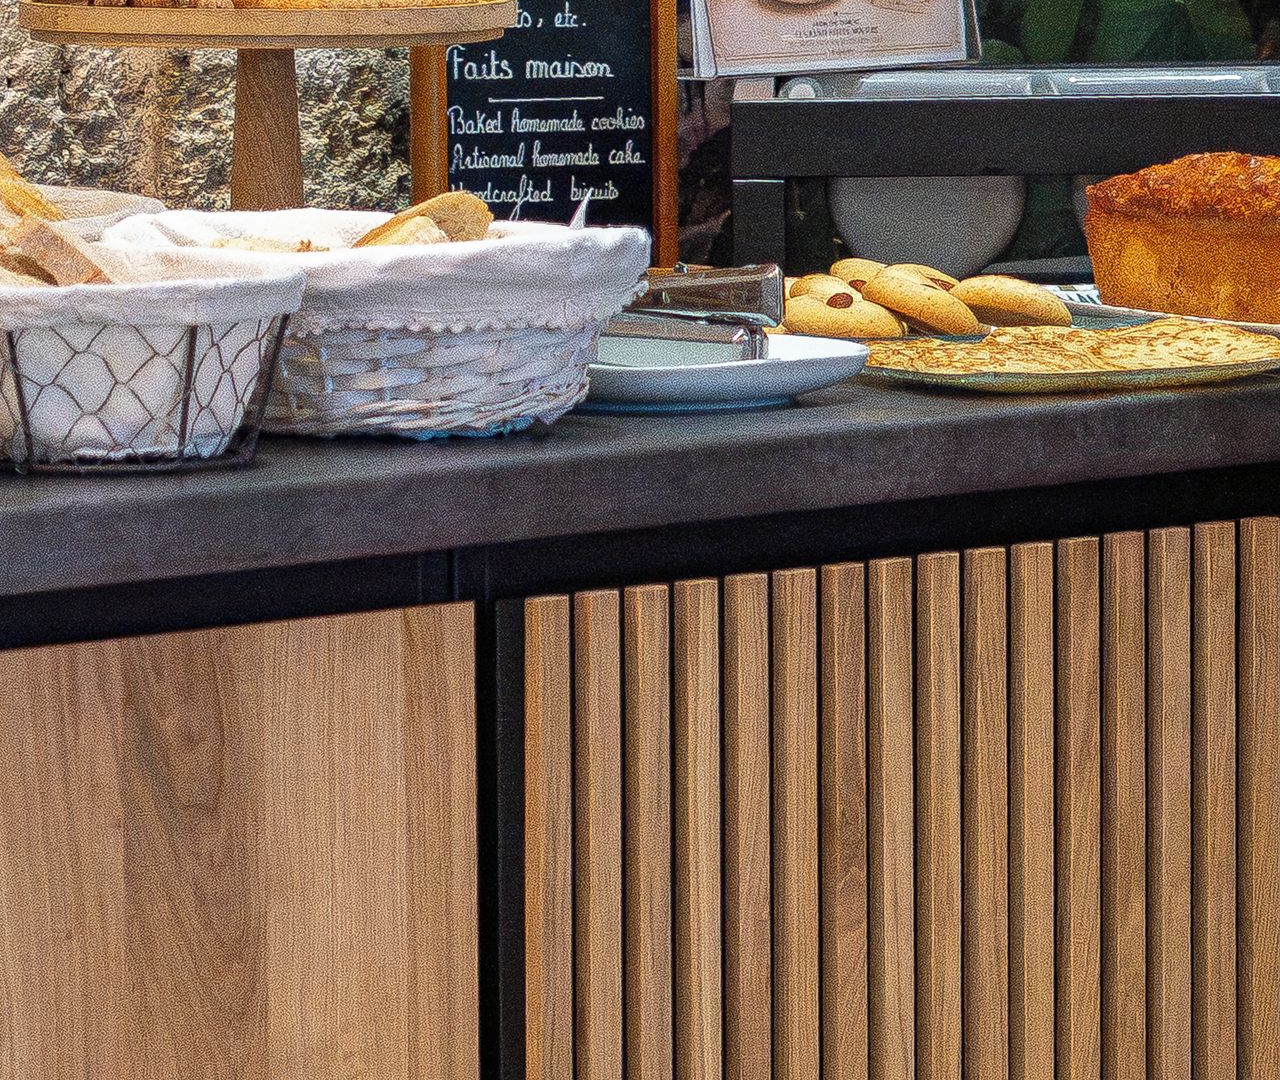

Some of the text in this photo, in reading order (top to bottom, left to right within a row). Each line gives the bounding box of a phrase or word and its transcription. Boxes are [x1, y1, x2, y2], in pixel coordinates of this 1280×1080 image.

[554, 1, 587, 28] etc.
[446, 44, 615, 80] Faits maison
[447, 105, 645, 135] Baked homemade cookies
[449, 143, 525, 173] Artisanal
[532, 140, 600, 168] homemade
